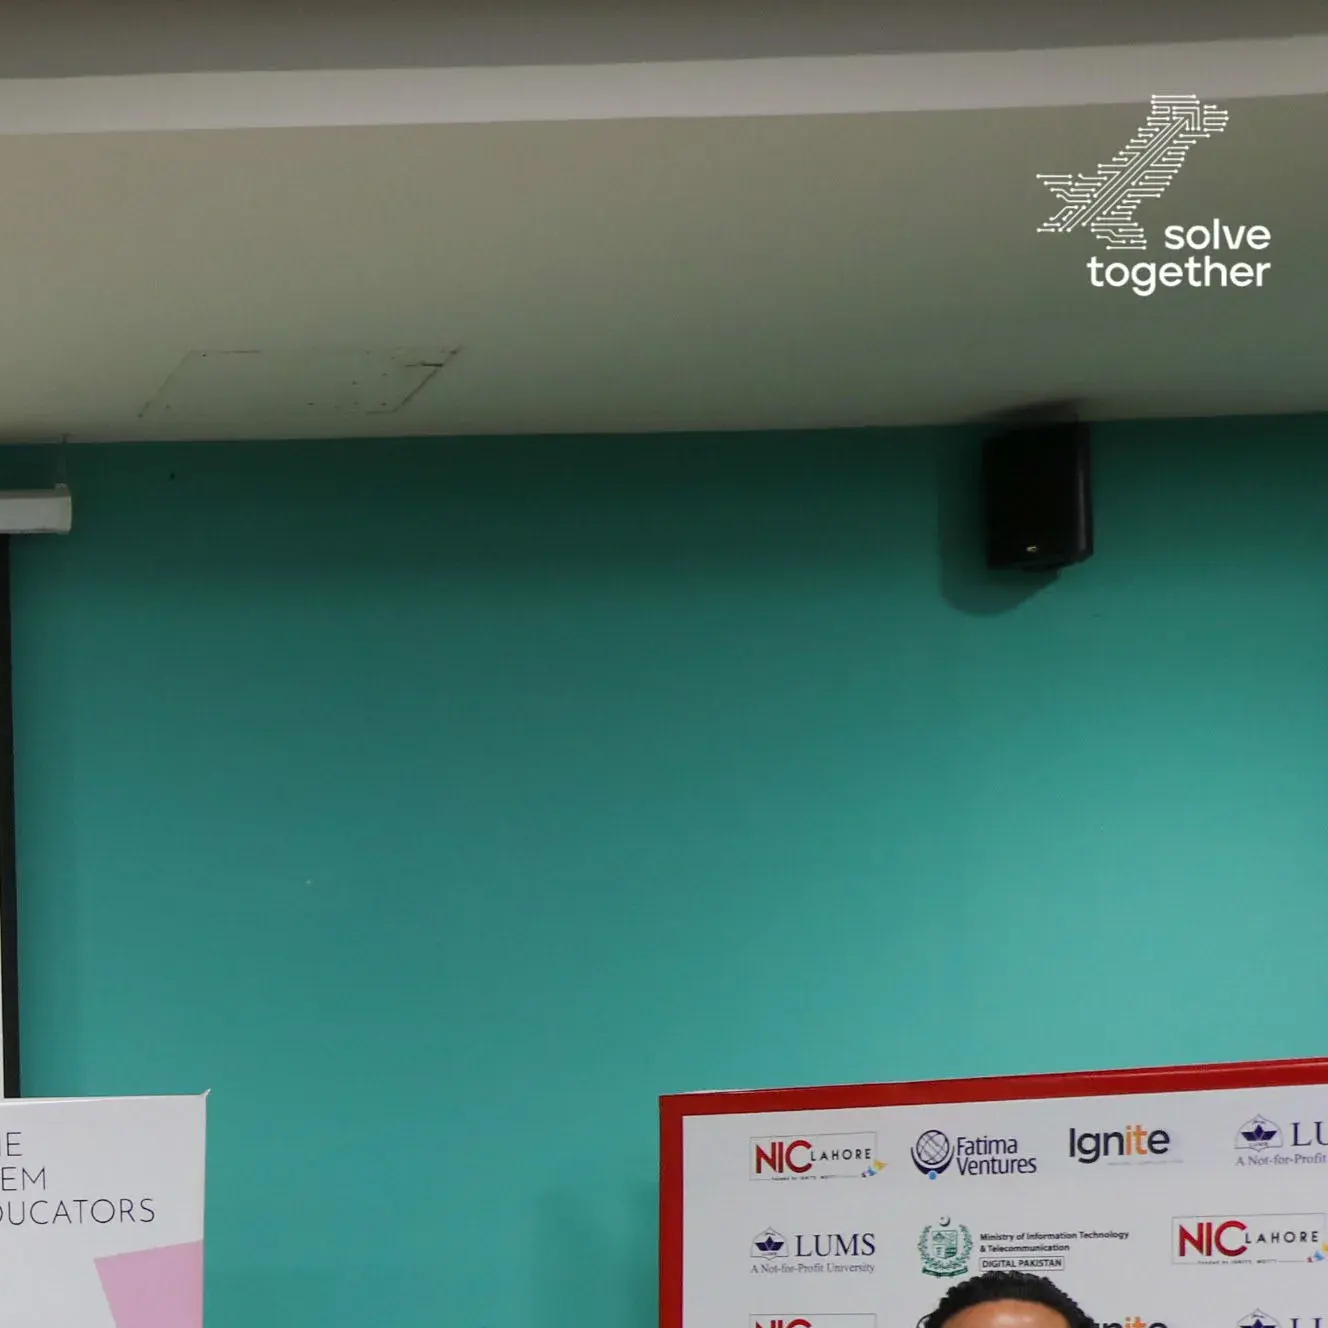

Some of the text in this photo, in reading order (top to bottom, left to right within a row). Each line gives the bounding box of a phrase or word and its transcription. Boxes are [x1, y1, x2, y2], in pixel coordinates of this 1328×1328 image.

[957, 1136, 1017, 1156] Fatima
[1070, 1125, 1170, 1164] Ignite
[756, 1140, 871, 1174] NIC LAHORE
[956, 1156, 1037, 1176] Ventures
[1235, 1154, 1326, 1166] A Not-for-Profit
[796, 1232, 876, 1257] LUMS
[980, 1233, 1014, 1241] Ministry
[1027, 1232, 1077, 1240] Information
[1079, 1231, 1129, 1239] Technology
[1179, 1220, 1318, 1256] NIC LAHORE
[750, 1263, 875, 1274] A Not-for-Profit University
[982, 1259, 1061, 1268] DIGITAL PAKISTAN
